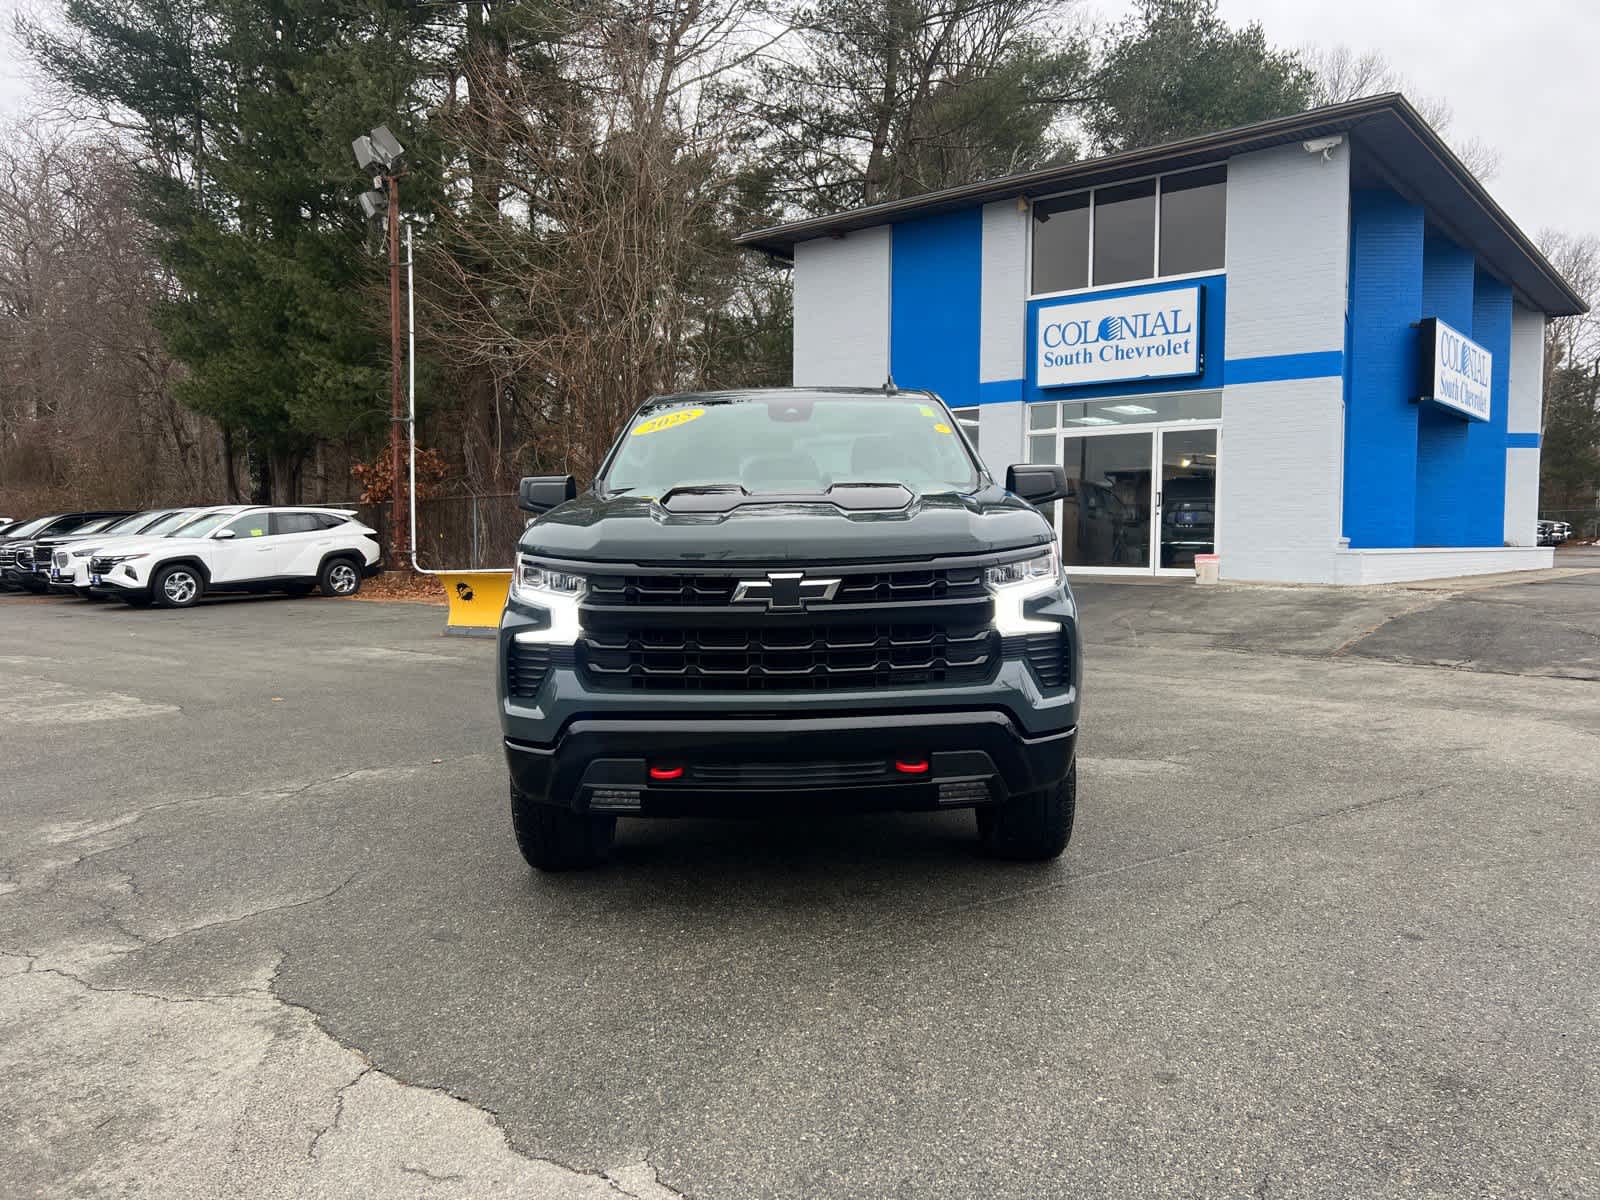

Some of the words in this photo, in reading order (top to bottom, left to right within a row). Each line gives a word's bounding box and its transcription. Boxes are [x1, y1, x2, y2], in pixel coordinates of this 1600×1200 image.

[1043, 309, 1191, 348] COLONIAL
[1043, 348, 1093, 367] South
[1098, 339, 1190, 362] Chevrolet
[1441, 331, 1488, 387] COLONIAL
[1440, 376, 1459, 400] South
